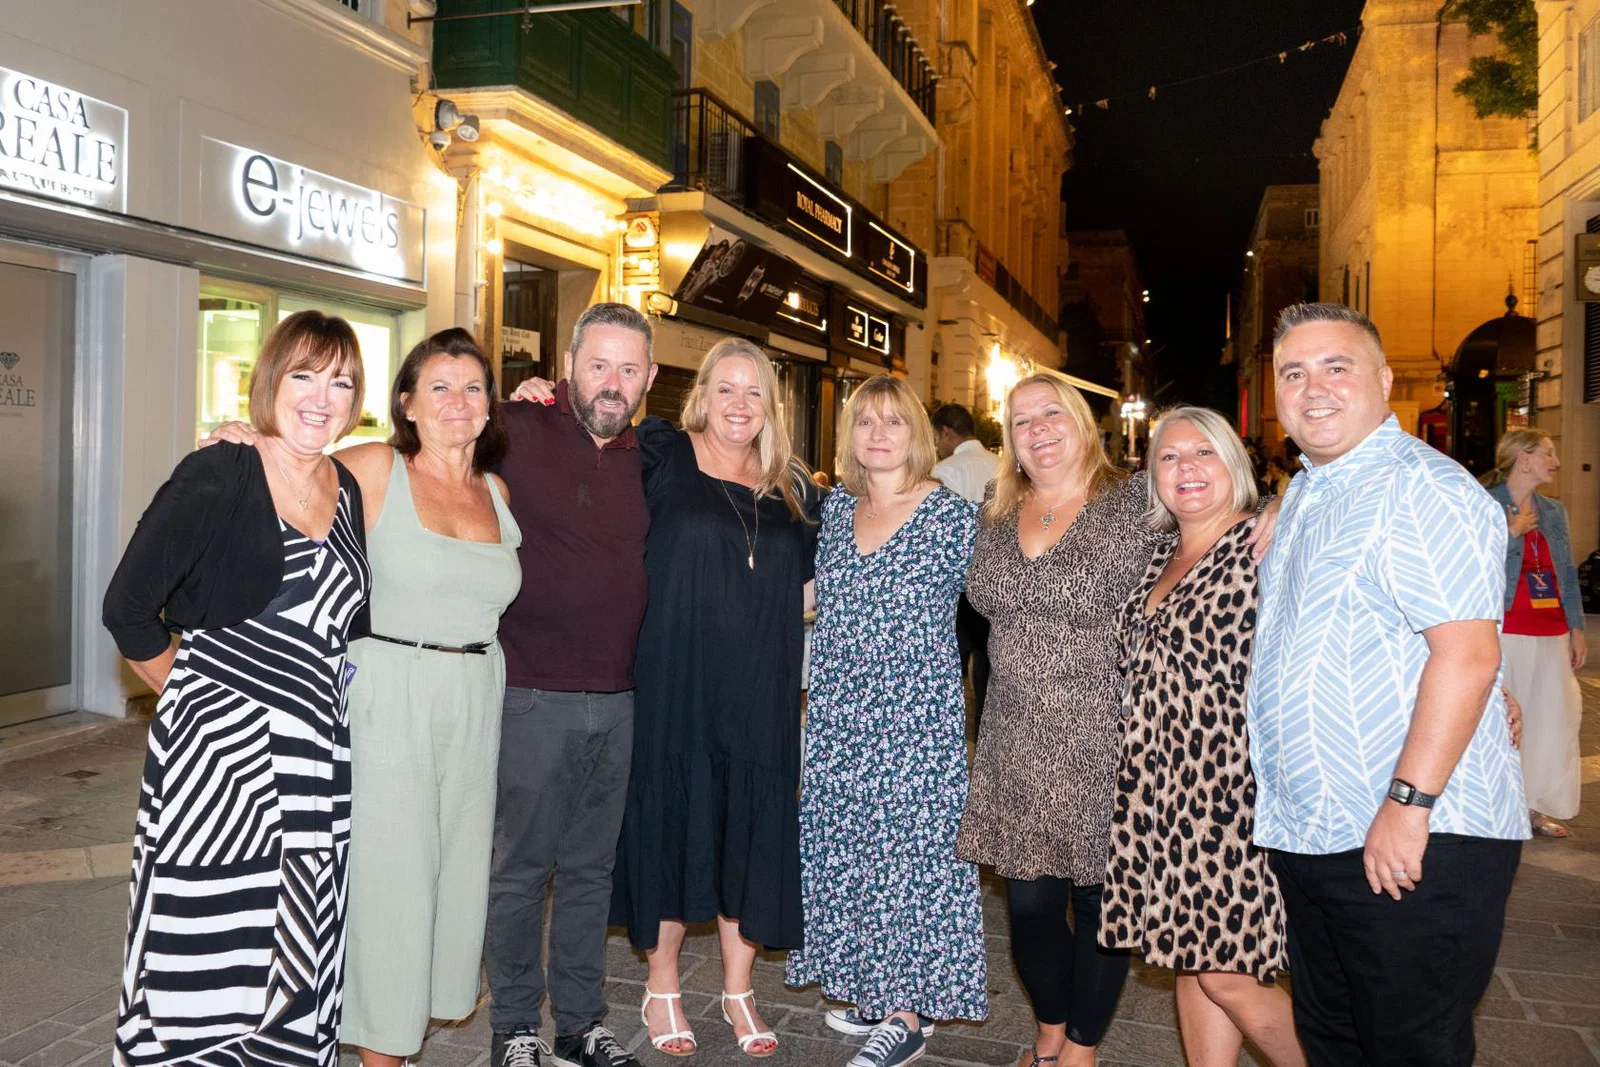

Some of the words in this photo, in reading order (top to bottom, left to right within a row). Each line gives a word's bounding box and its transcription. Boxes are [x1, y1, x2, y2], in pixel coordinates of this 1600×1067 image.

[13, 78, 91, 130] CASA
[241, 154, 399, 249] e-jewels
[796, 191, 815, 217] ROYAL
[814, 203, 842, 234] PHARMACY
